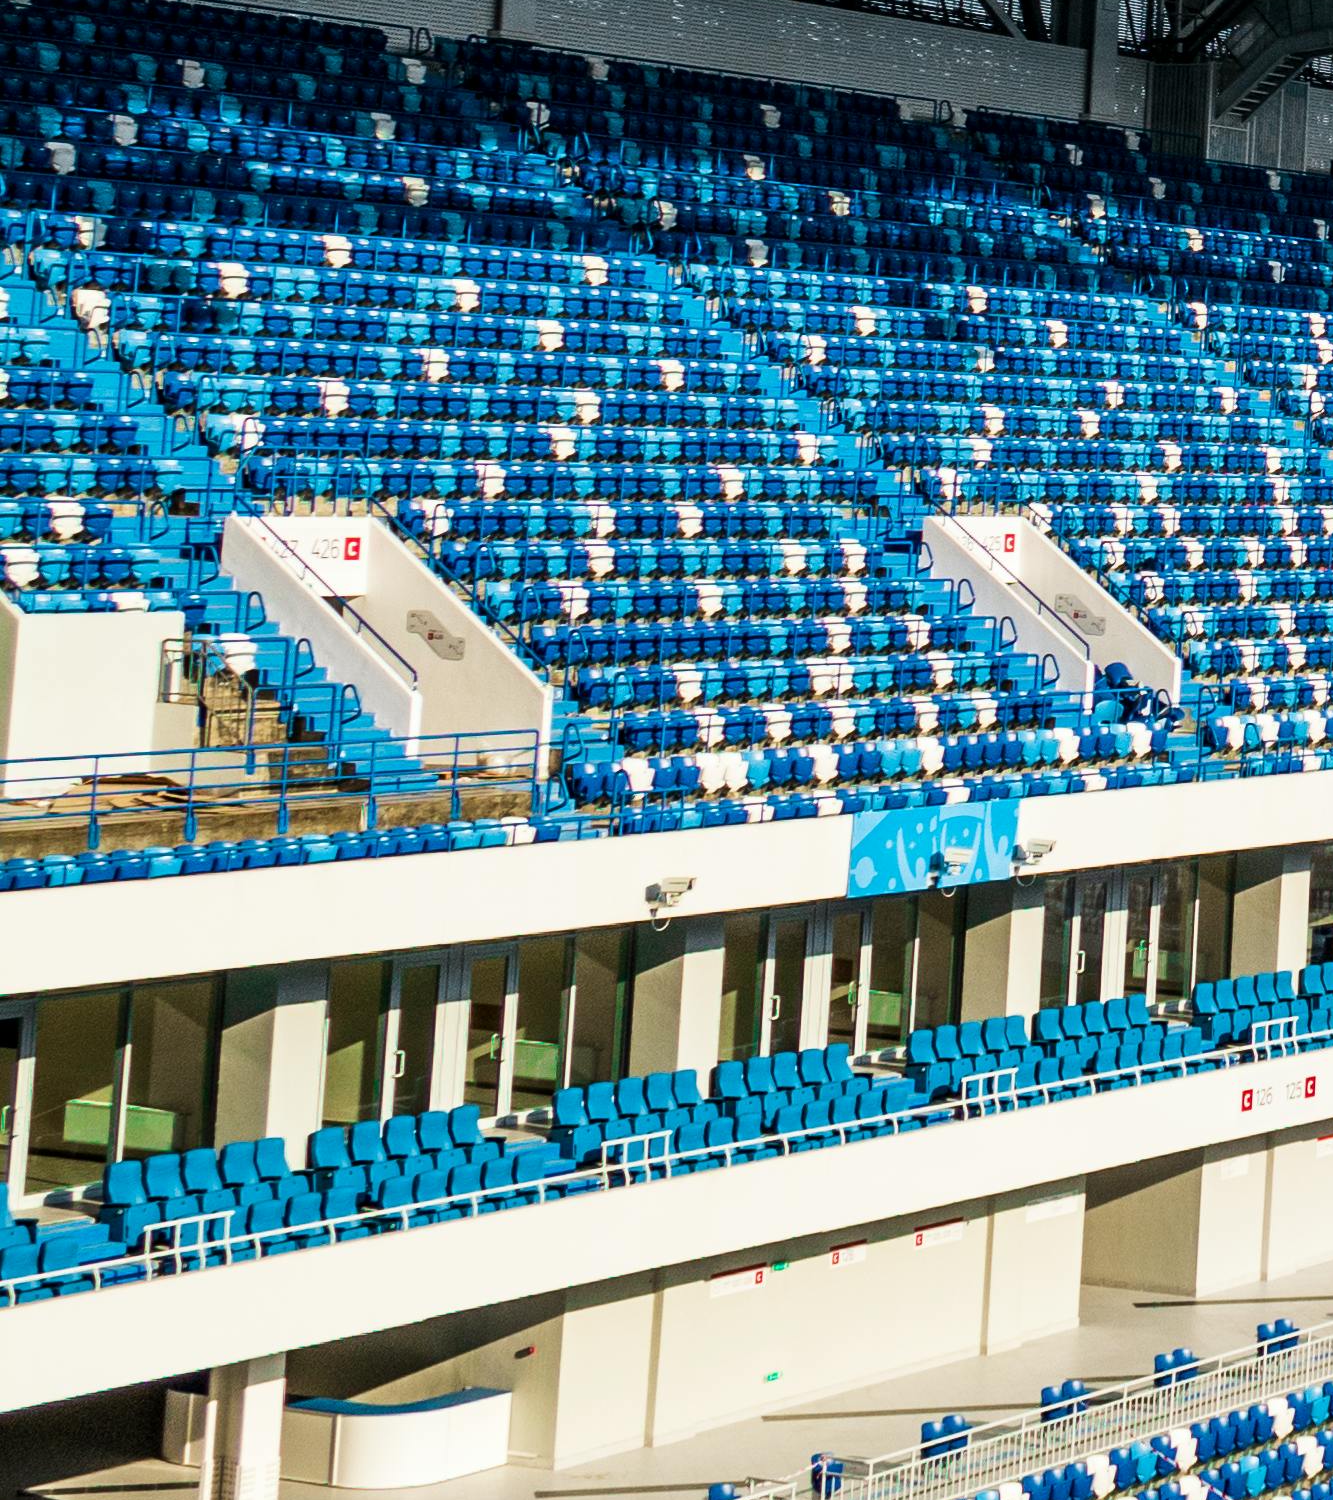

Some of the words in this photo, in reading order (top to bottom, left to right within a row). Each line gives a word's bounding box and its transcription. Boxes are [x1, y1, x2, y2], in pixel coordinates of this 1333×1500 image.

[311, 537, 339, 559] 426
[1256, 1087, 1272, 1105] 126
[1286, 1081, 1302, 1100] 125
